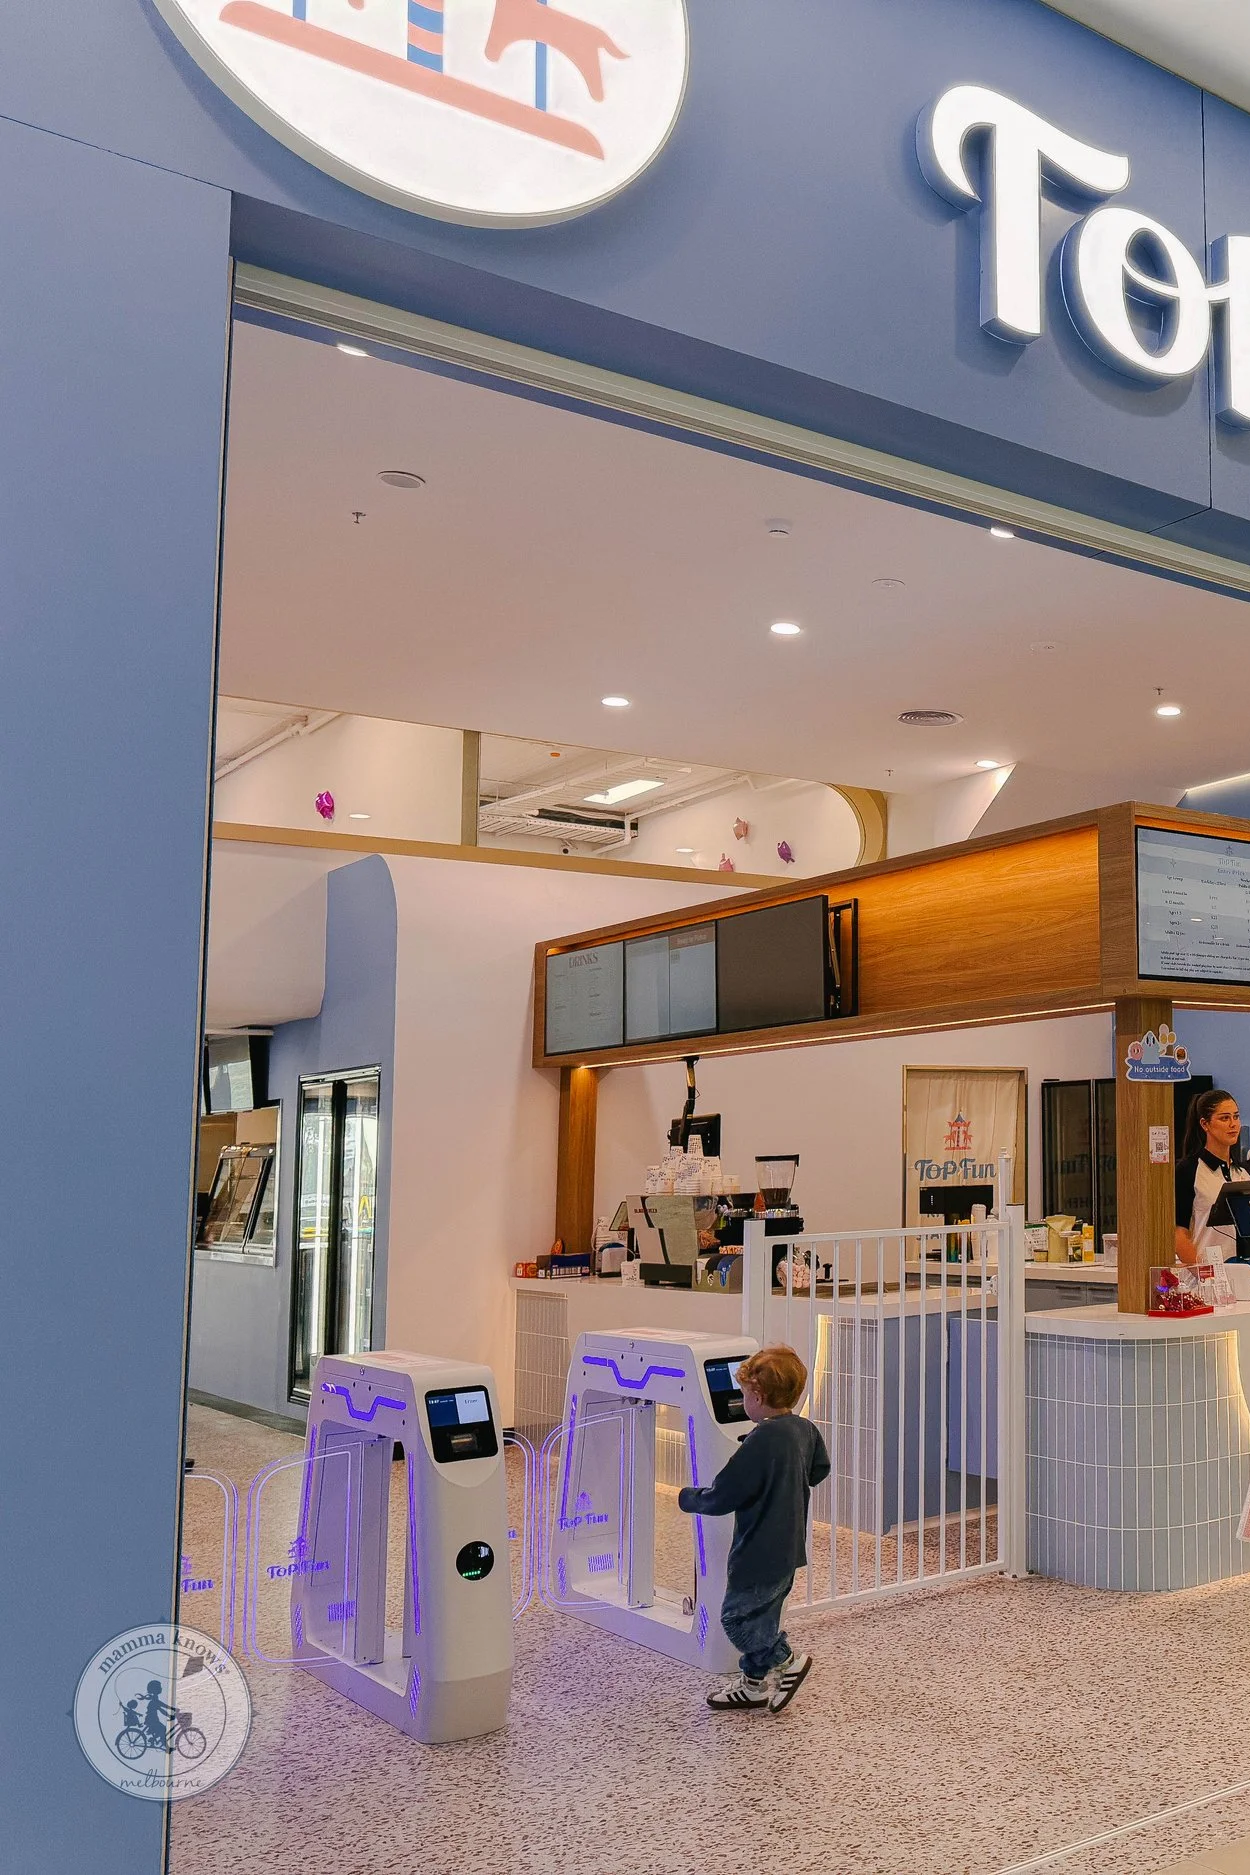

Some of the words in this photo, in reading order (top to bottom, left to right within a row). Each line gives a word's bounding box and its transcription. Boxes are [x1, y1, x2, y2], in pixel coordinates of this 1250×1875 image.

[568, 952, 599, 969] DRINKS
[1134, 1065, 1143, 1073] No
[1144, 1065, 1169, 1073] outside
[1170, 1065, 1185, 1073] food
[959, 1157, 997, 1180] Fun
